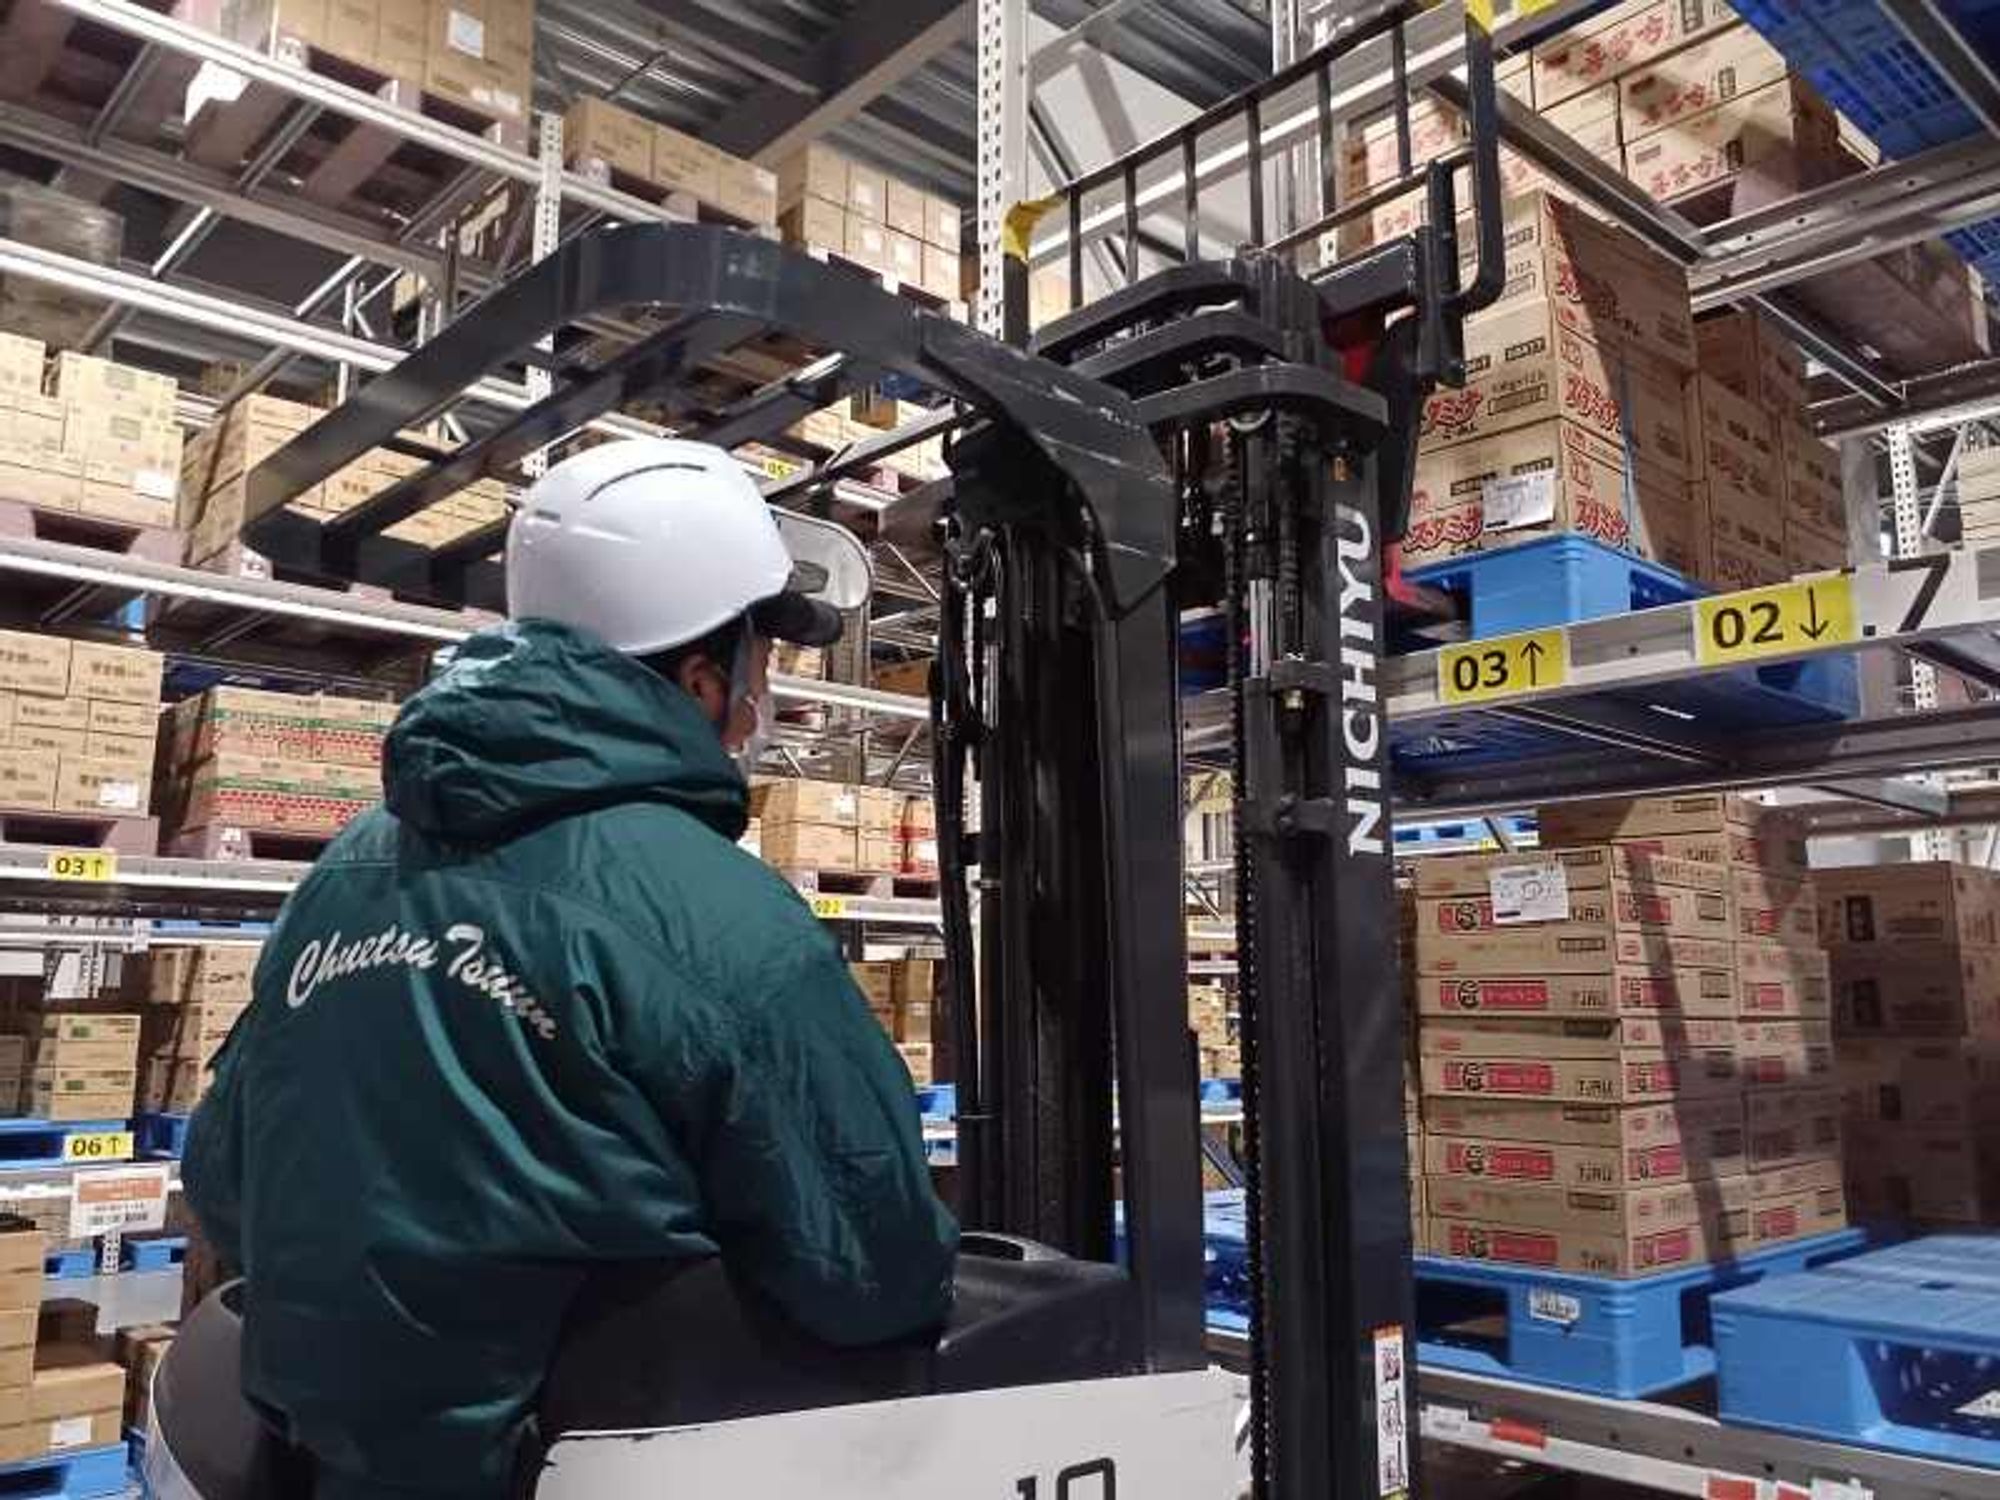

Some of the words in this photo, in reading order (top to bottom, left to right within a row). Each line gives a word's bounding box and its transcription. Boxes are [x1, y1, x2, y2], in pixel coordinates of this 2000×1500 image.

[1713, 602, 1783, 648] 02
[1335, 503, 1384, 855] NICHIYU
[1453, 653, 1508, 691] 03
[56, 857, 85, 876] 03
[73, 1138, 102, 1156] 06
